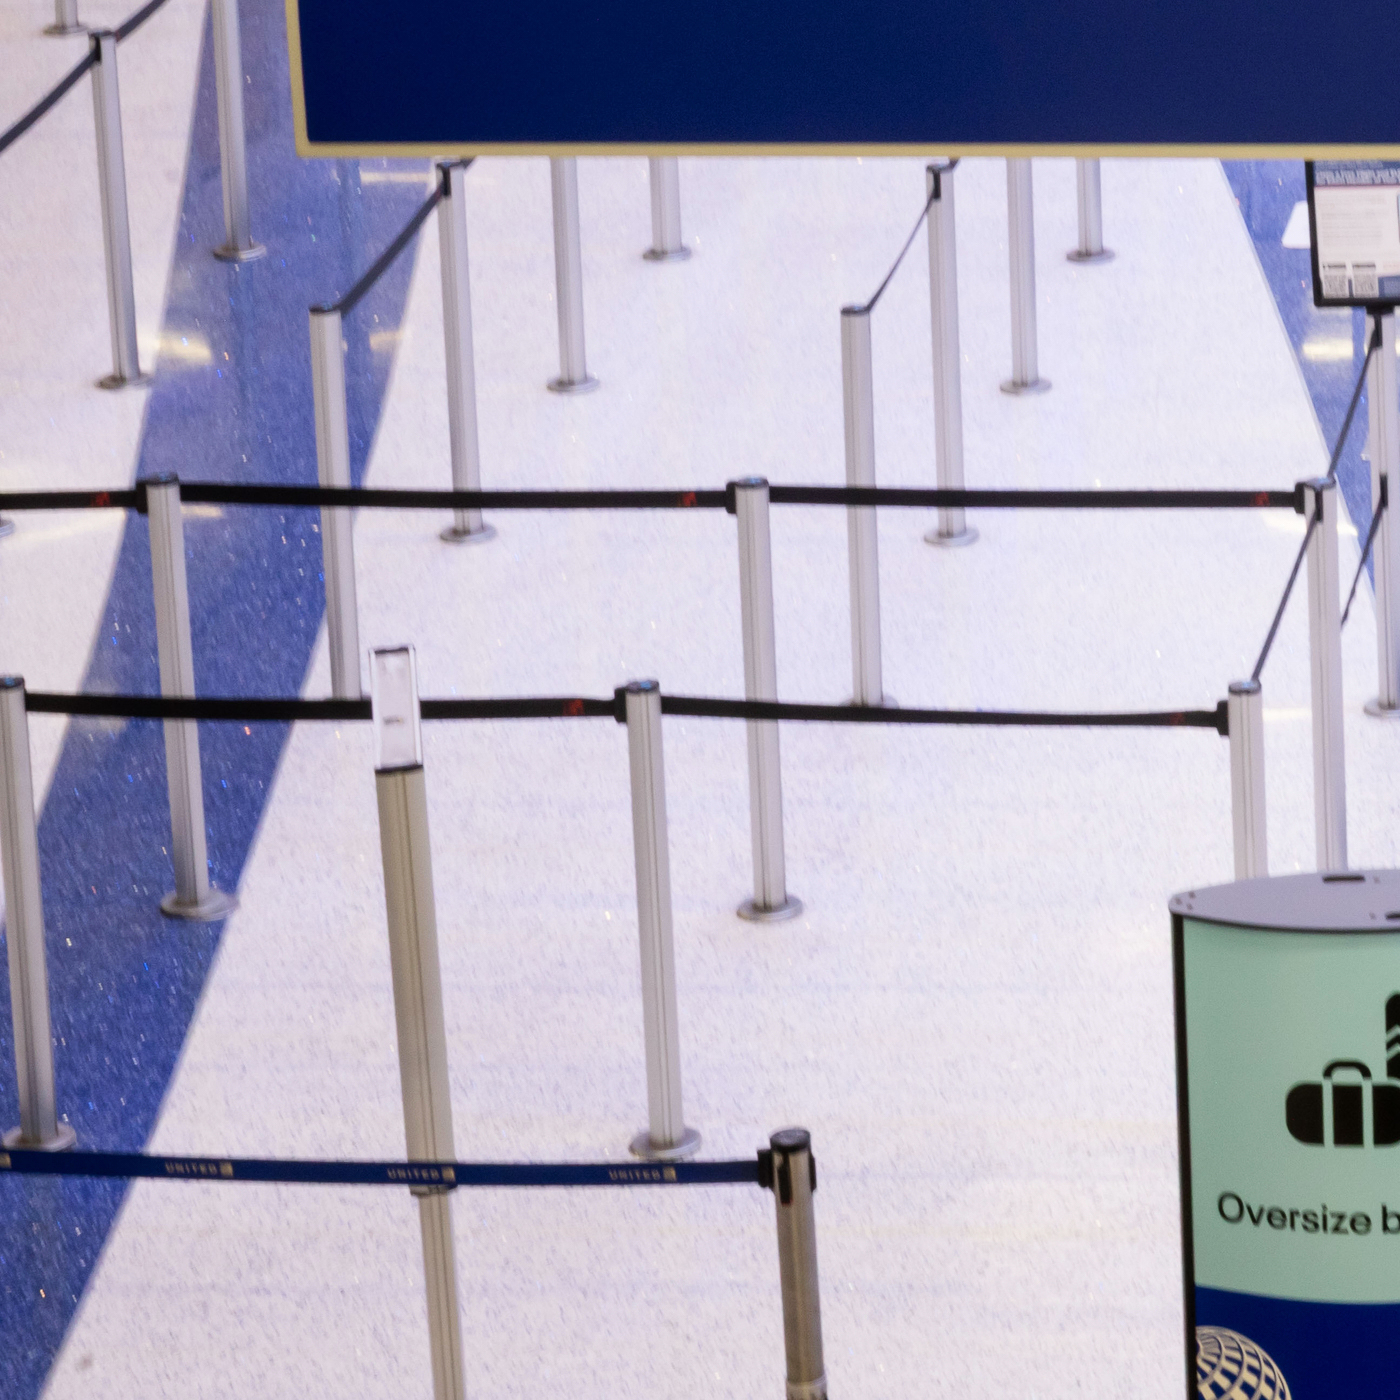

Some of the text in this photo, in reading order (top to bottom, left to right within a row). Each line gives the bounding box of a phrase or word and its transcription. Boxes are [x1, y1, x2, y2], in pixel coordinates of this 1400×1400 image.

[165, 1162, 218, 1176] UNITED
[387, 1168, 440, 1181] UNITED
[608, 1169, 661, 1182] UNITED
[1217, 1192, 1372, 1236] Oversize
